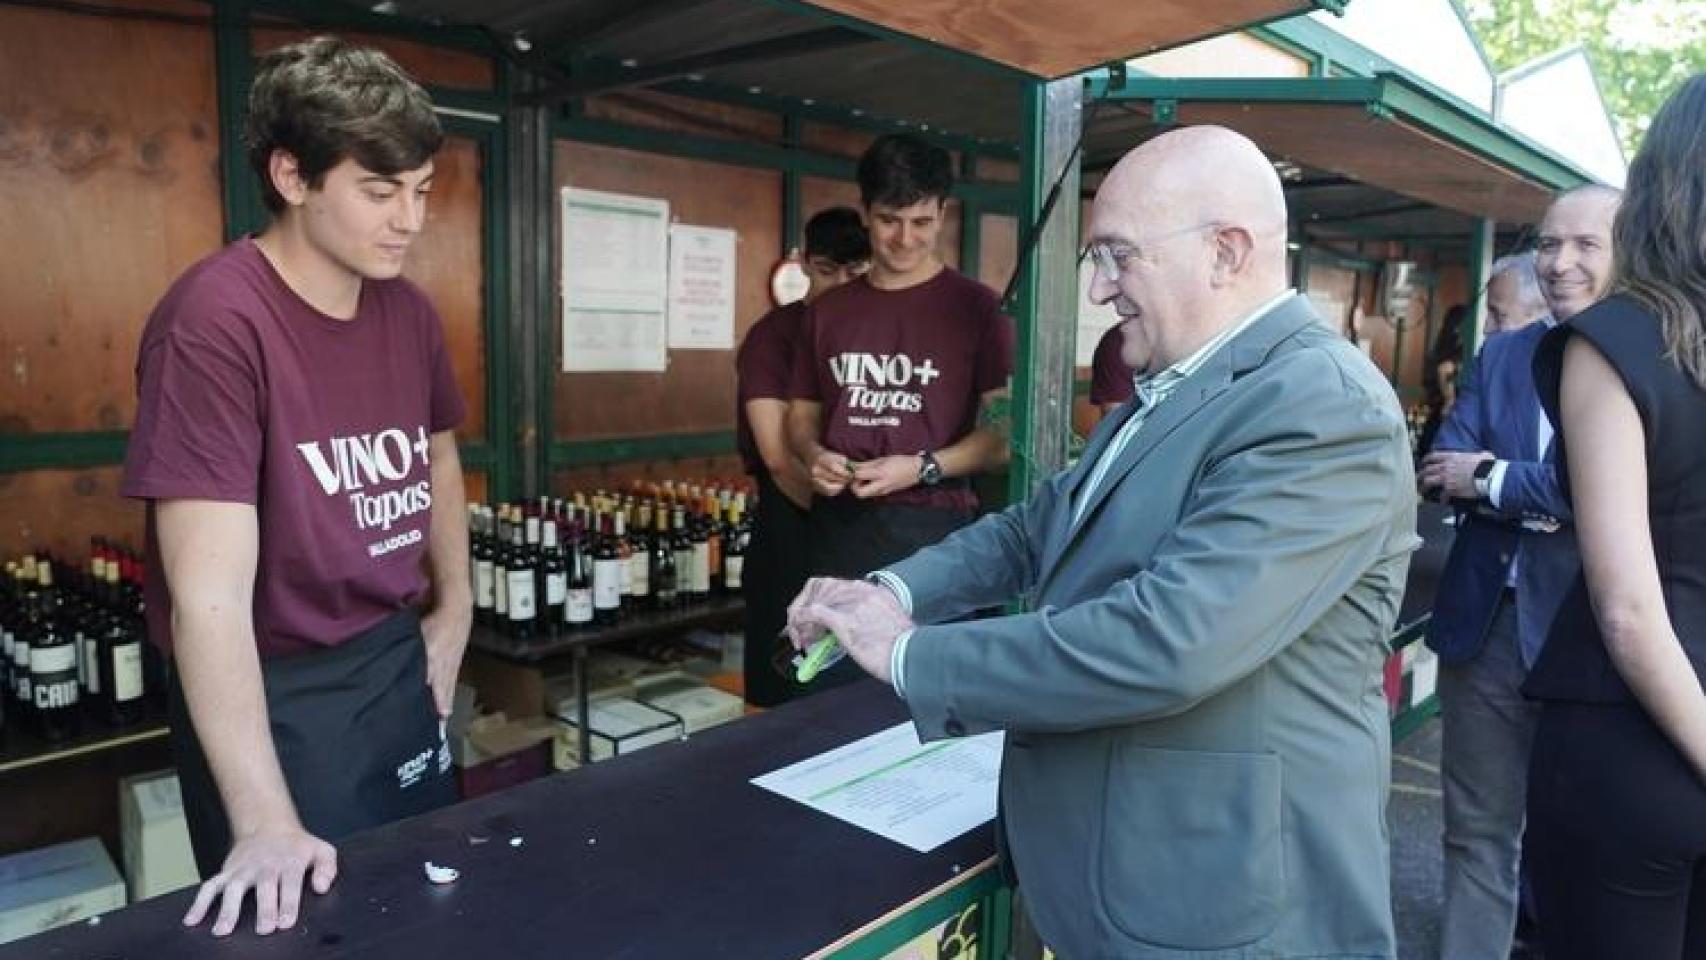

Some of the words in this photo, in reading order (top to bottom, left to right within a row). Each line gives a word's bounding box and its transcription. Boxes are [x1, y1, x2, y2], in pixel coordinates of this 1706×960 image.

[828, 352, 940, 387] VINO+
[848, 386, 921, 414] Tapas
[296, 425, 429, 495] VINO+
[350, 482, 432, 530] Tapas
